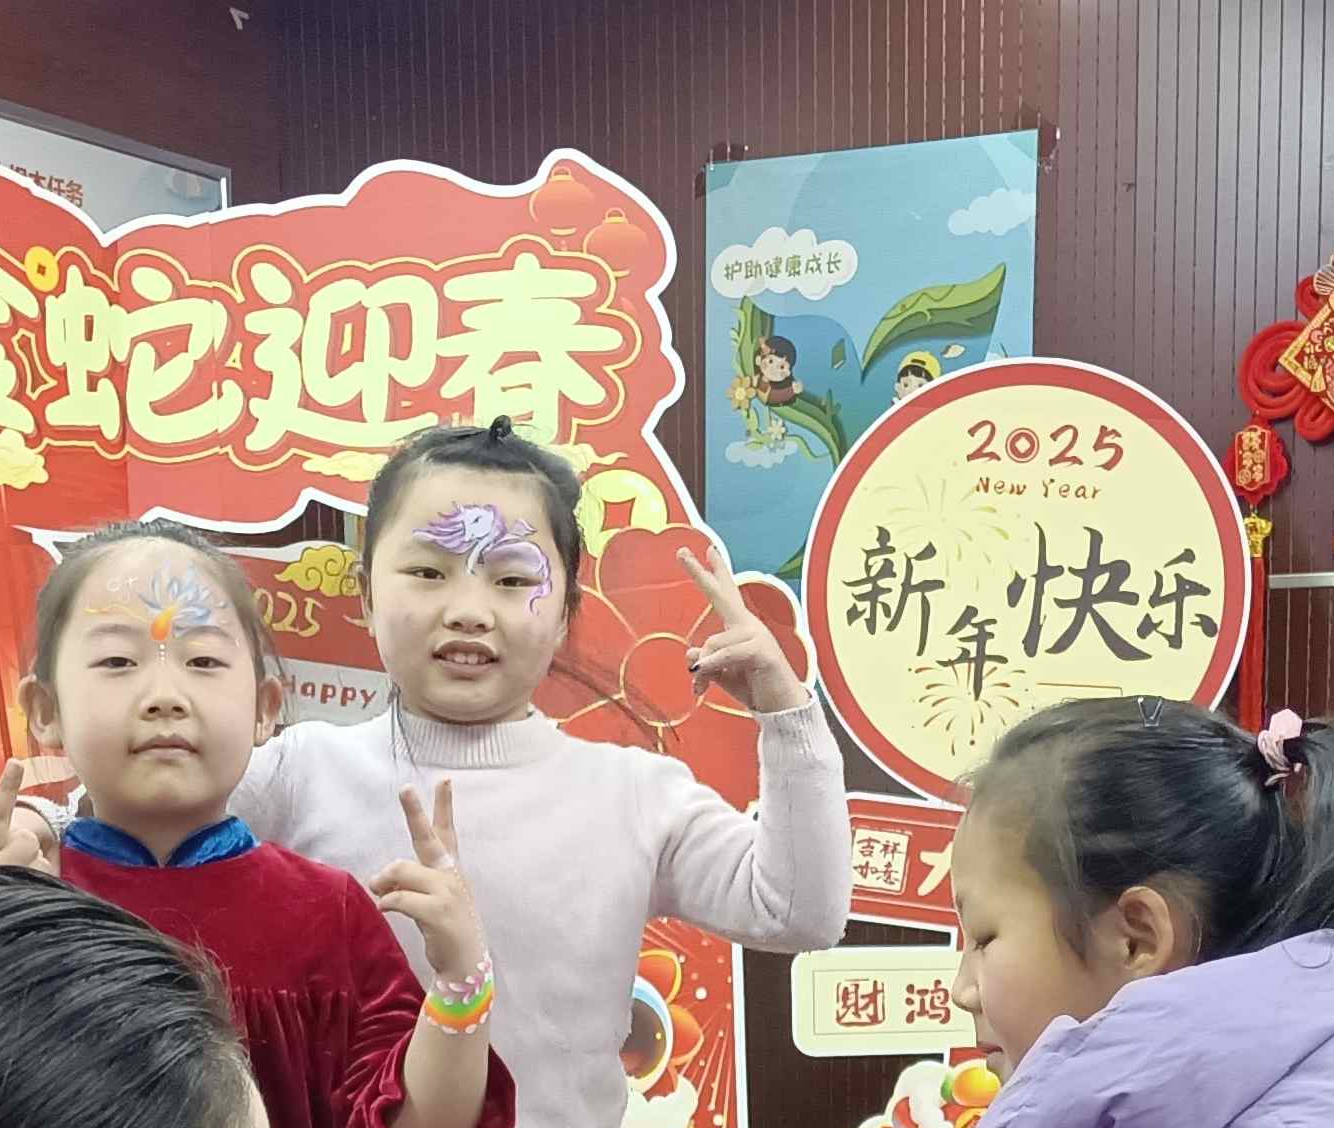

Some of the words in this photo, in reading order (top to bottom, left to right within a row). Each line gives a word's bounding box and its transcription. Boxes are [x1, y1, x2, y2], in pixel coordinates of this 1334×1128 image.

[724, 252, 842, 280] 护助健康成长
[966, 420, 1124, 471] 2025
[975, 476, 1027, 497] New
[1041, 478, 1102, 501] Year
[254, 587, 325, 637] 025
[842, 520, 1219, 701] 新年快乐
[856, 837, 905, 861] 吉祥
[852, 861, 900, 886] 如意
[905, 979, 951, 1024] 鸿
